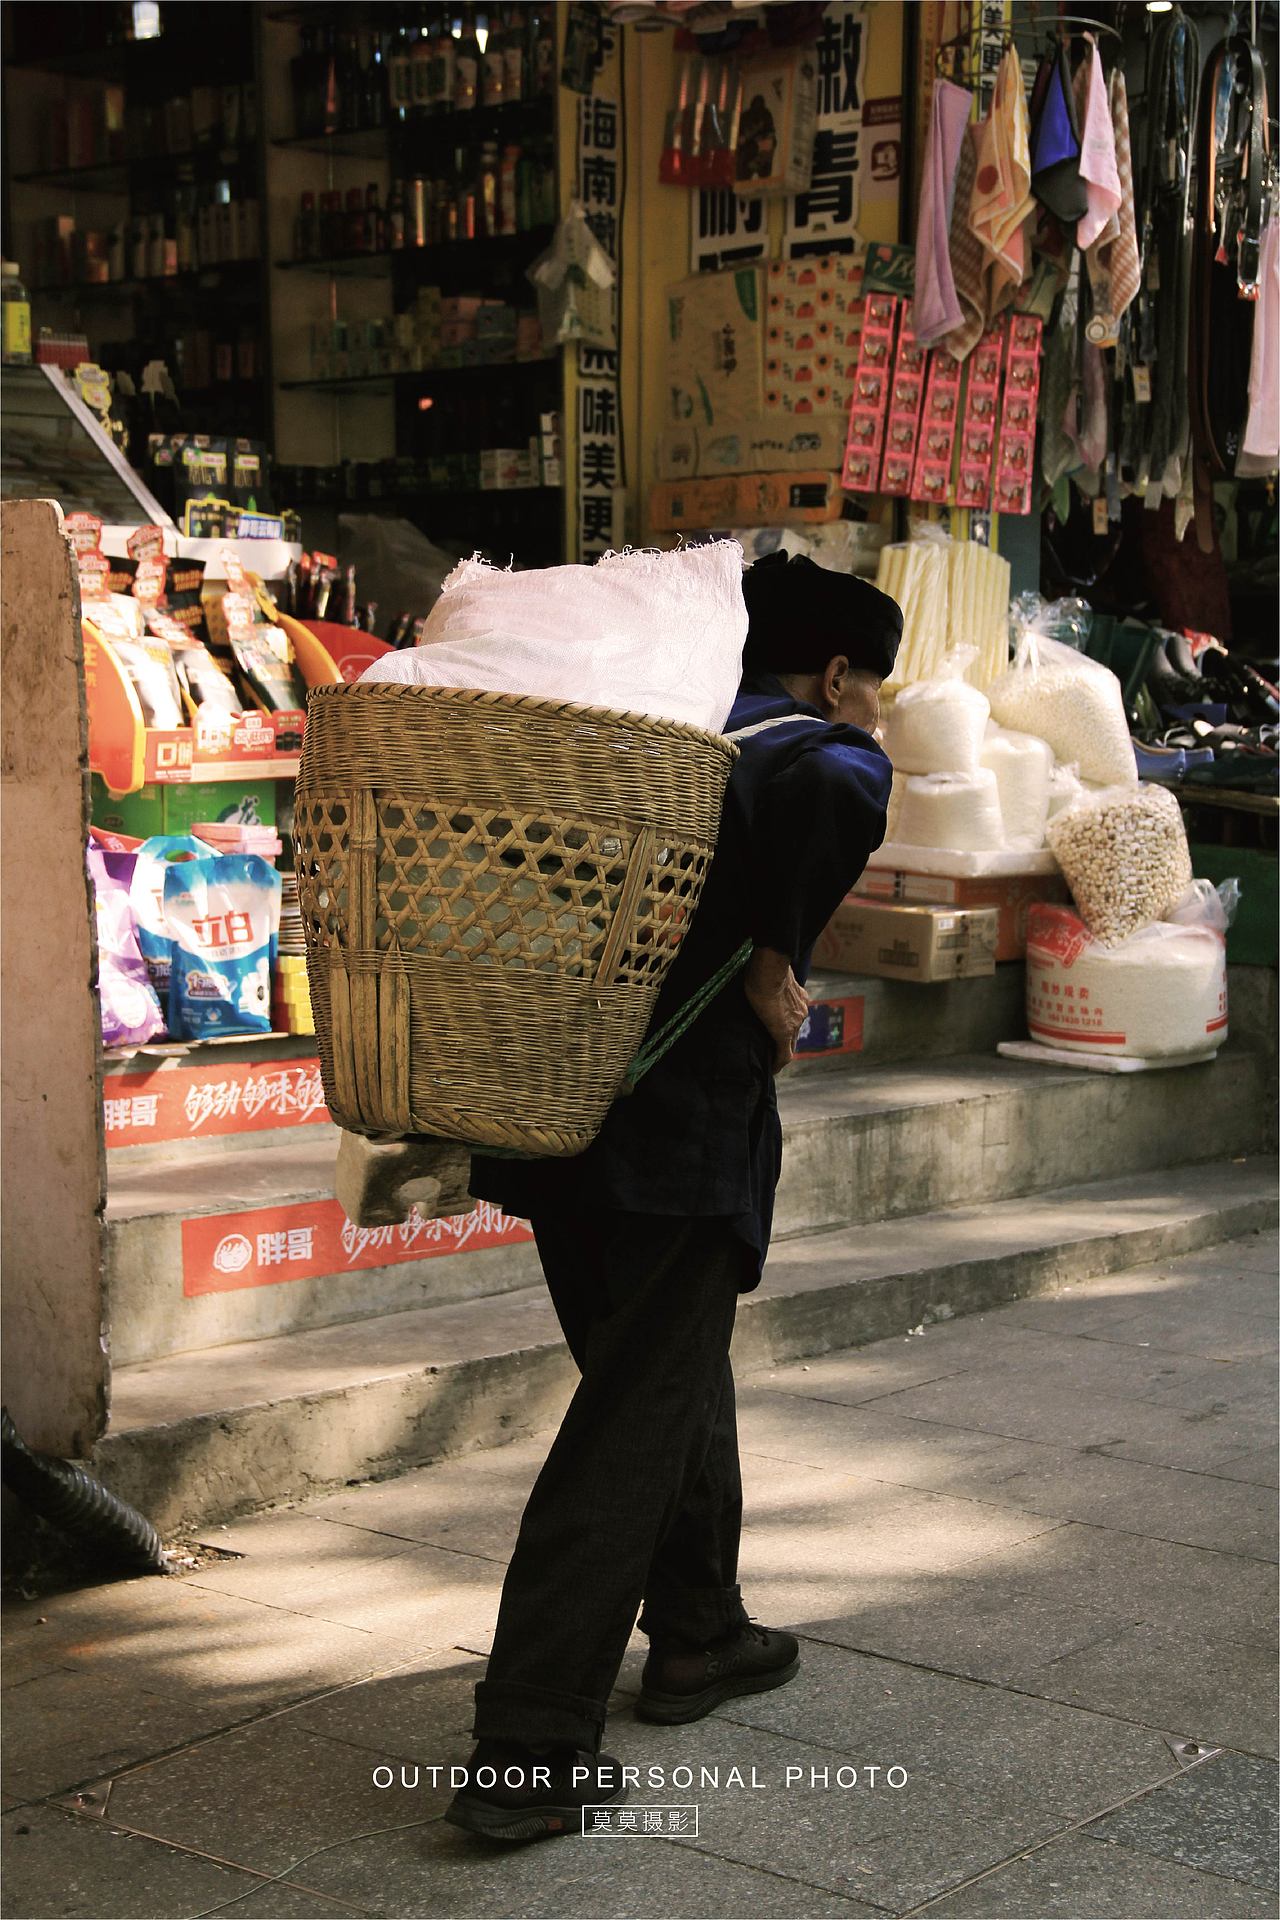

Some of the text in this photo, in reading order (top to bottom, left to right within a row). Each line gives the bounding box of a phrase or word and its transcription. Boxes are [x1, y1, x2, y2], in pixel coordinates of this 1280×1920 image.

[191, 911, 254, 948] 立白
[103, 1094, 158, 1131] 胖哥
[256, 1227, 314, 1267] 胖哥
